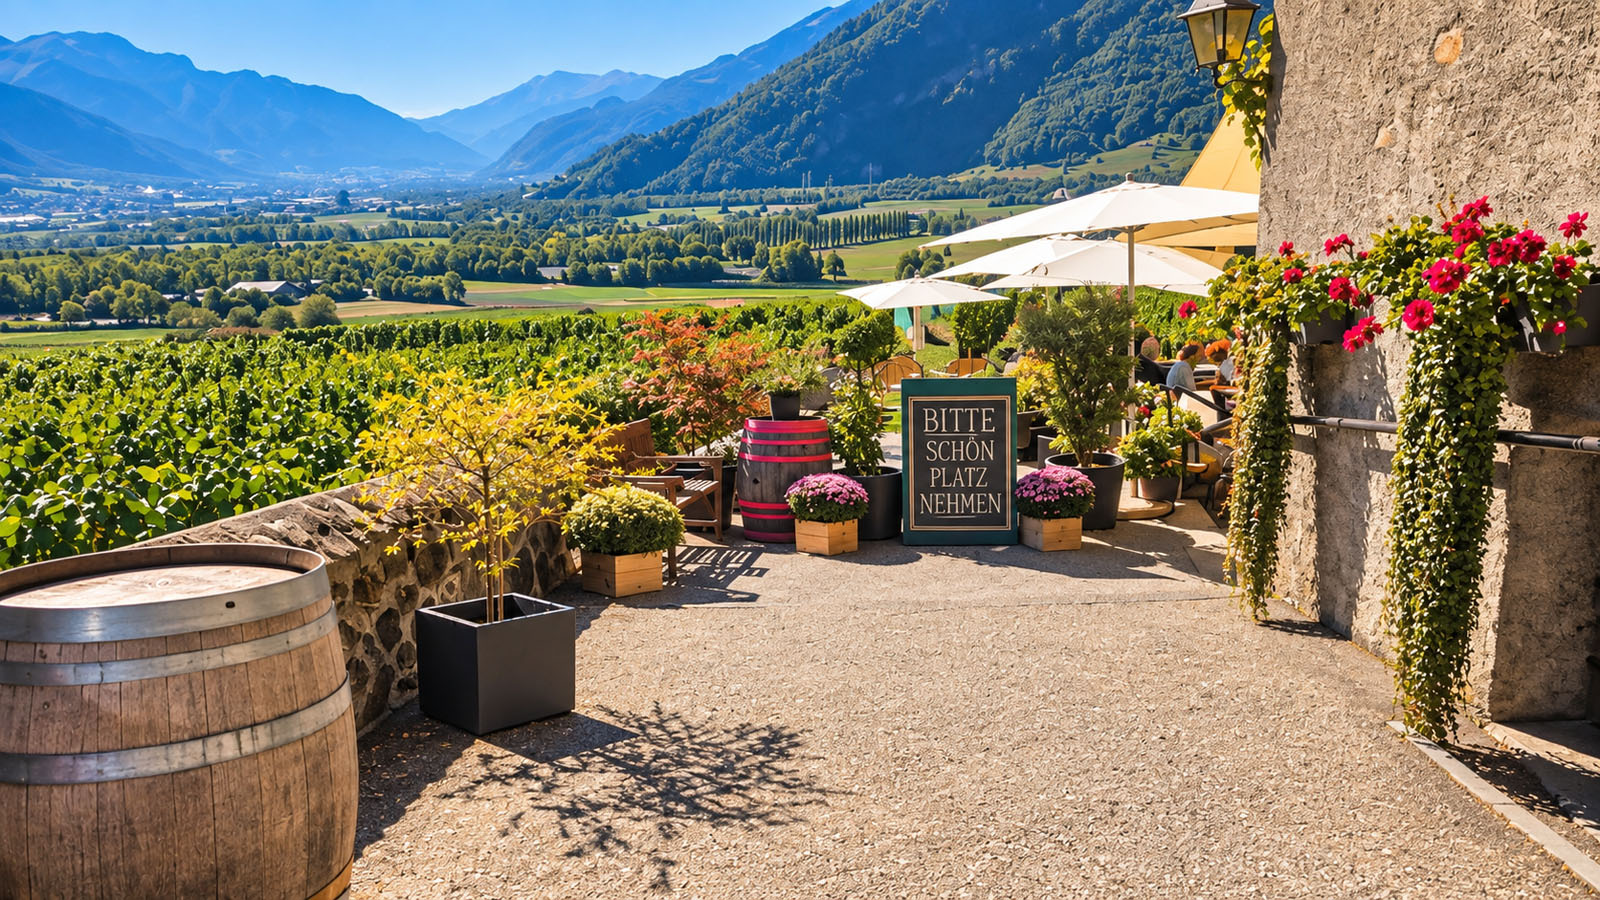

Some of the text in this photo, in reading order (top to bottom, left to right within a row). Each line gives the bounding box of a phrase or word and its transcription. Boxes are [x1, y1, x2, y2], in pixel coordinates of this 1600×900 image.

[922, 408, 996, 433] BITTE
[926, 437, 994, 462] SCHÖN
[930, 467, 988, 488] PLATZ
[920, 493, 1002, 514] NEHMEN
